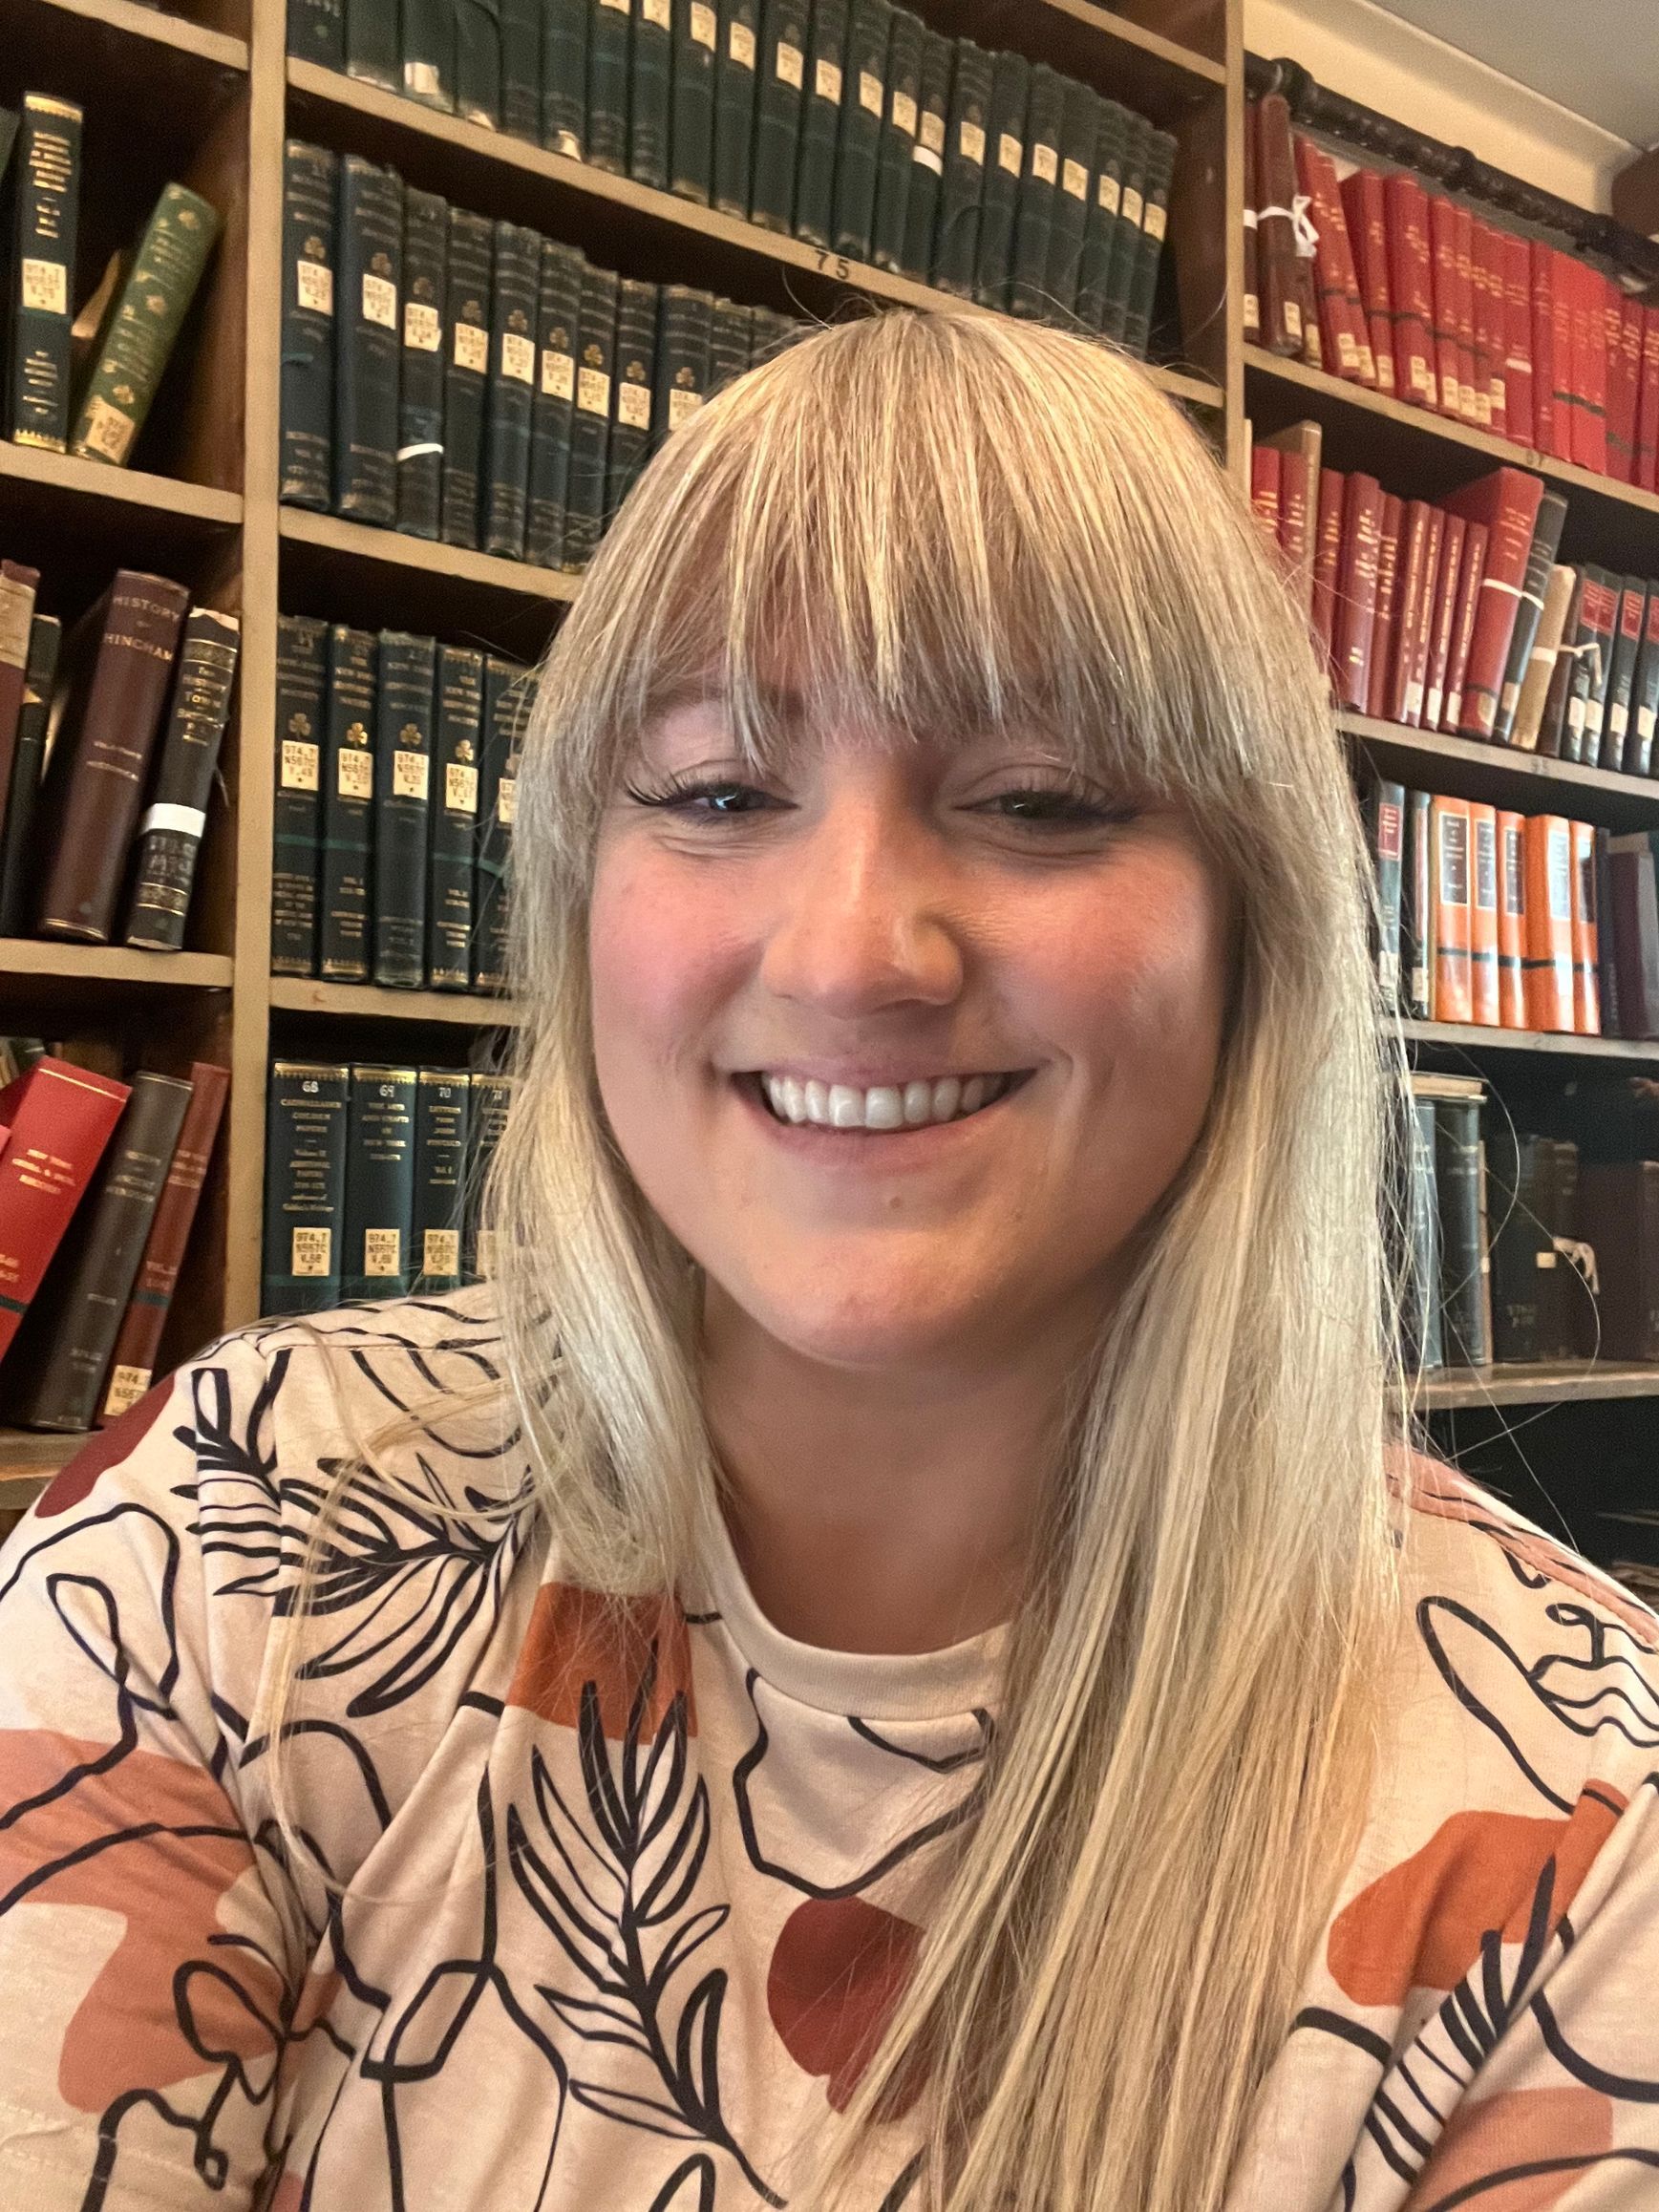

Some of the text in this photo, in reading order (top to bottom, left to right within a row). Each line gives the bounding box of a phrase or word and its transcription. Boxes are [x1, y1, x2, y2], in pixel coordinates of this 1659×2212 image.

[815, 251, 849, 281] 75
[113, 596, 181, 623] HISTORY
[302, 1080, 319, 1094] 68
[379, 1084, 395, 1098] 69
[438, 1086, 452, 1098] 70
[296, 1231, 327, 1243] 974.7
[369, 1233, 396, 1243] 974.7
